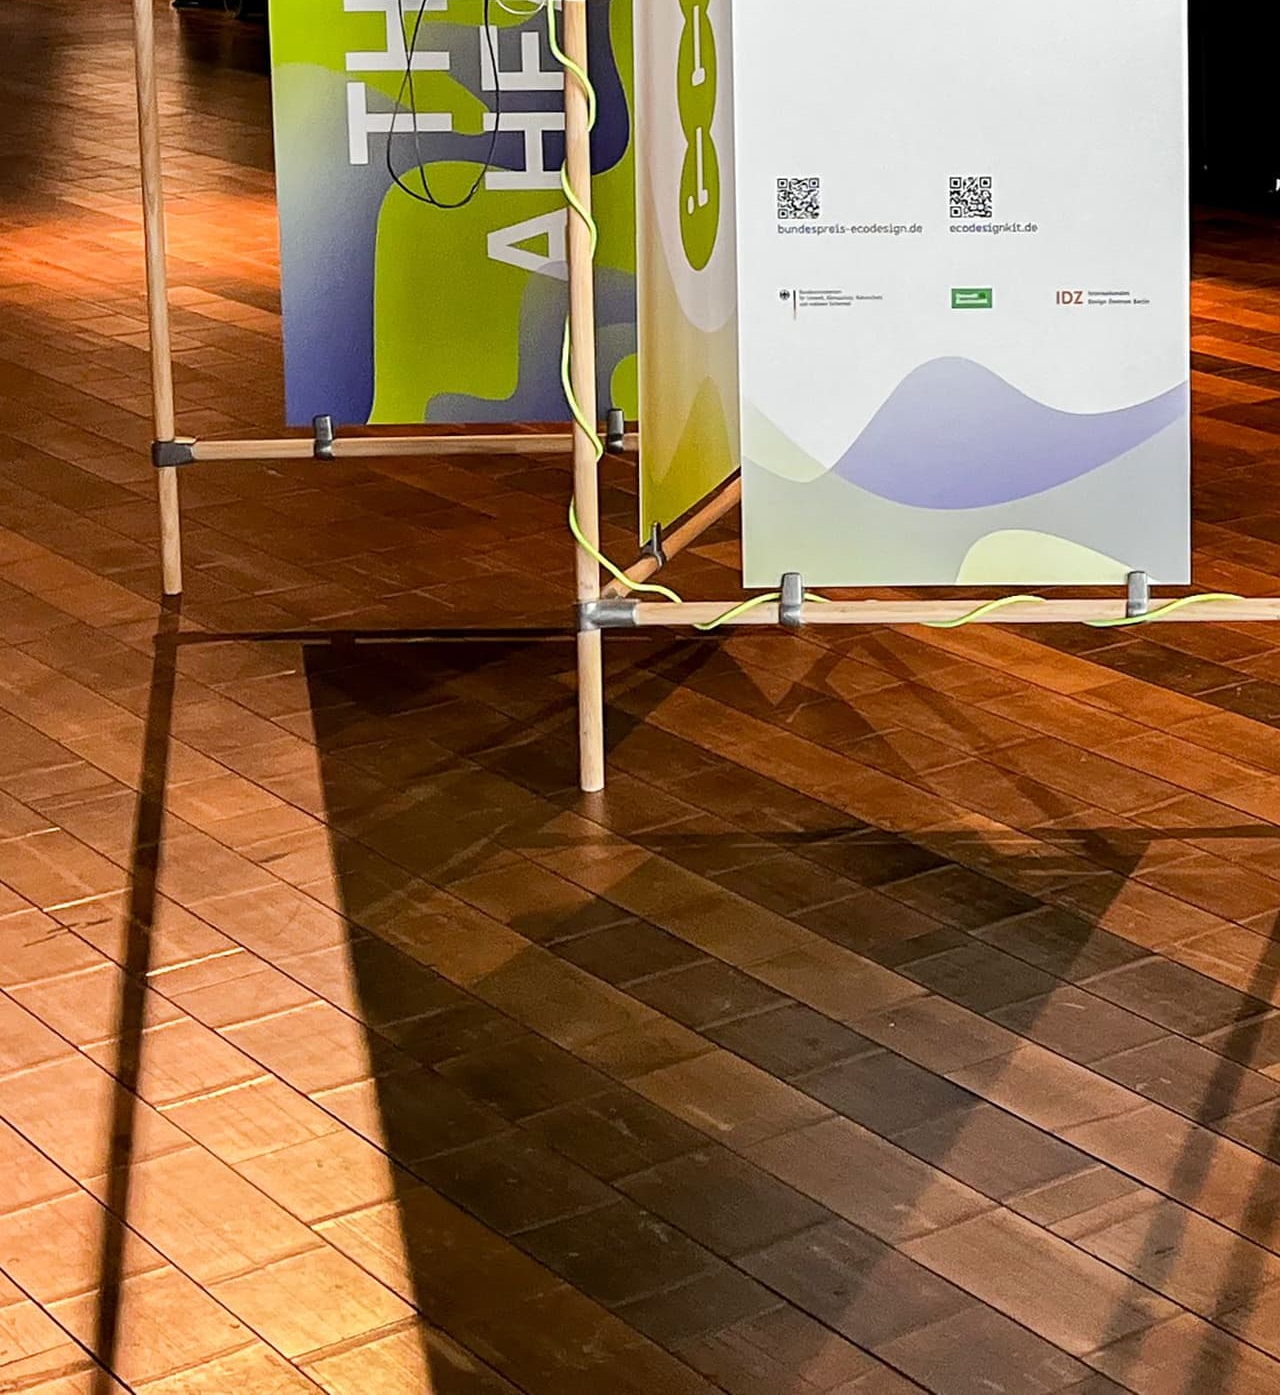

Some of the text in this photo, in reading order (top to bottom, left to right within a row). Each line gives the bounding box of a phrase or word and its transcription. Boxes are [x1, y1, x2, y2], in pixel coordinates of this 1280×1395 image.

[777, 223, 922, 236] bundespreis-ecodesign.de
[949, 222, 1038, 236] ecodesignkit.de
[1056, 291, 1084, 305] IDZ
